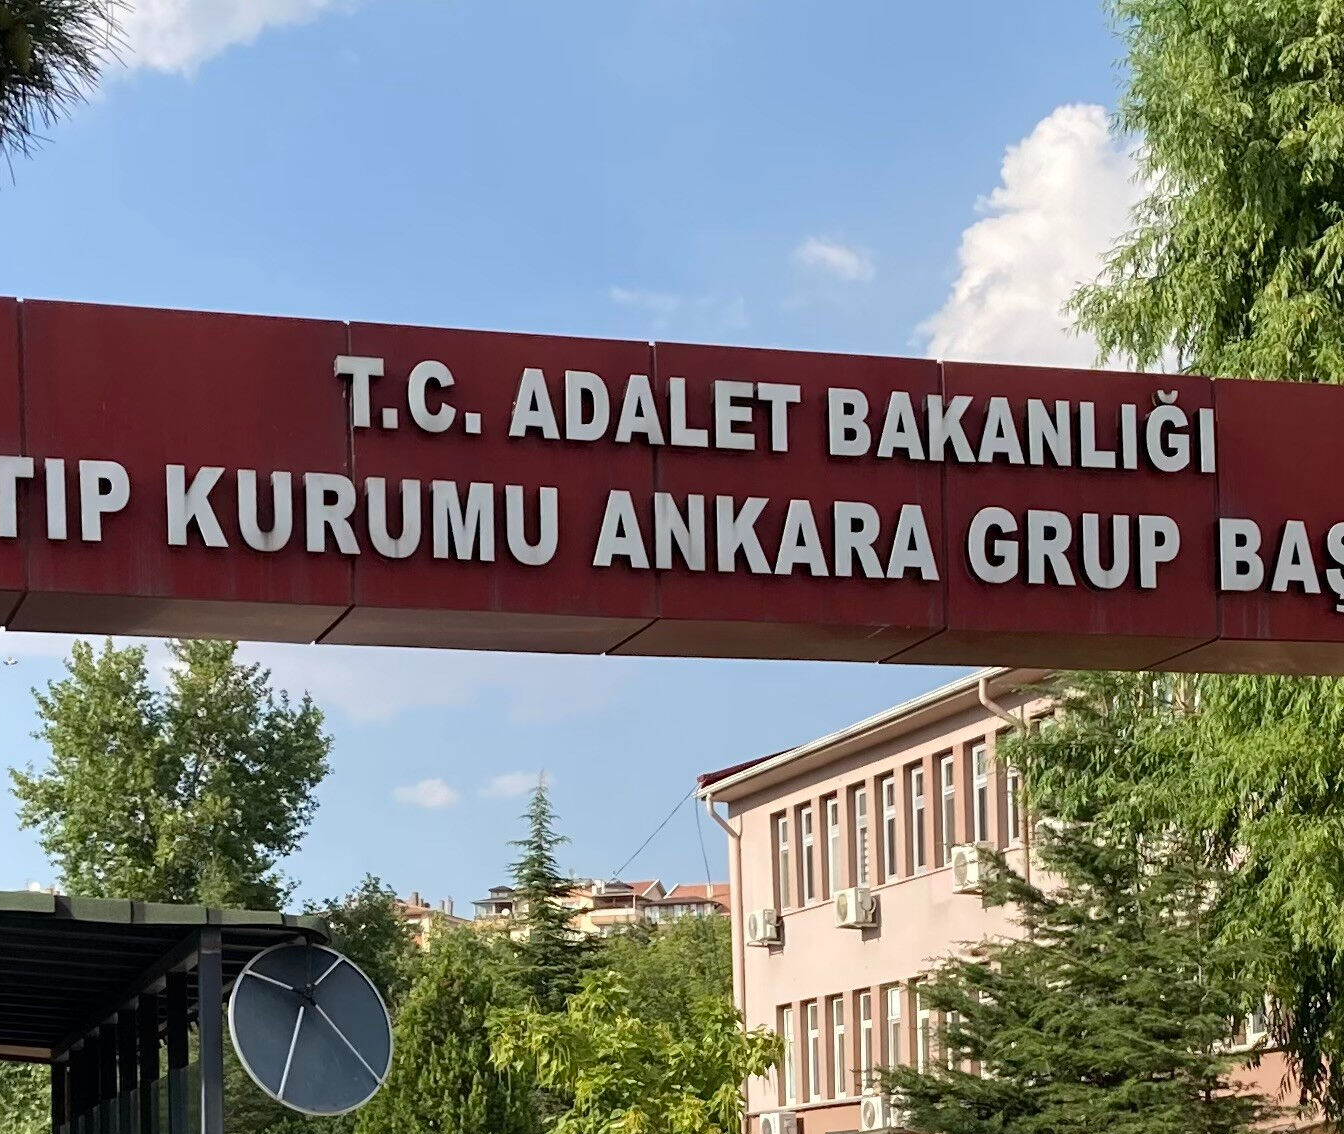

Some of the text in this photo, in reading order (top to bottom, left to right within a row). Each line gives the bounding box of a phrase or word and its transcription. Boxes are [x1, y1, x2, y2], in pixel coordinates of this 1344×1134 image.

[334, 355, 1216, 474] T.C. ADALET BAKANLIĞI
[165, 464, 558, 566] KURUMU
[592, 489, 940, 582] ANKARA
[968, 507, 1180, 589] GRUP
